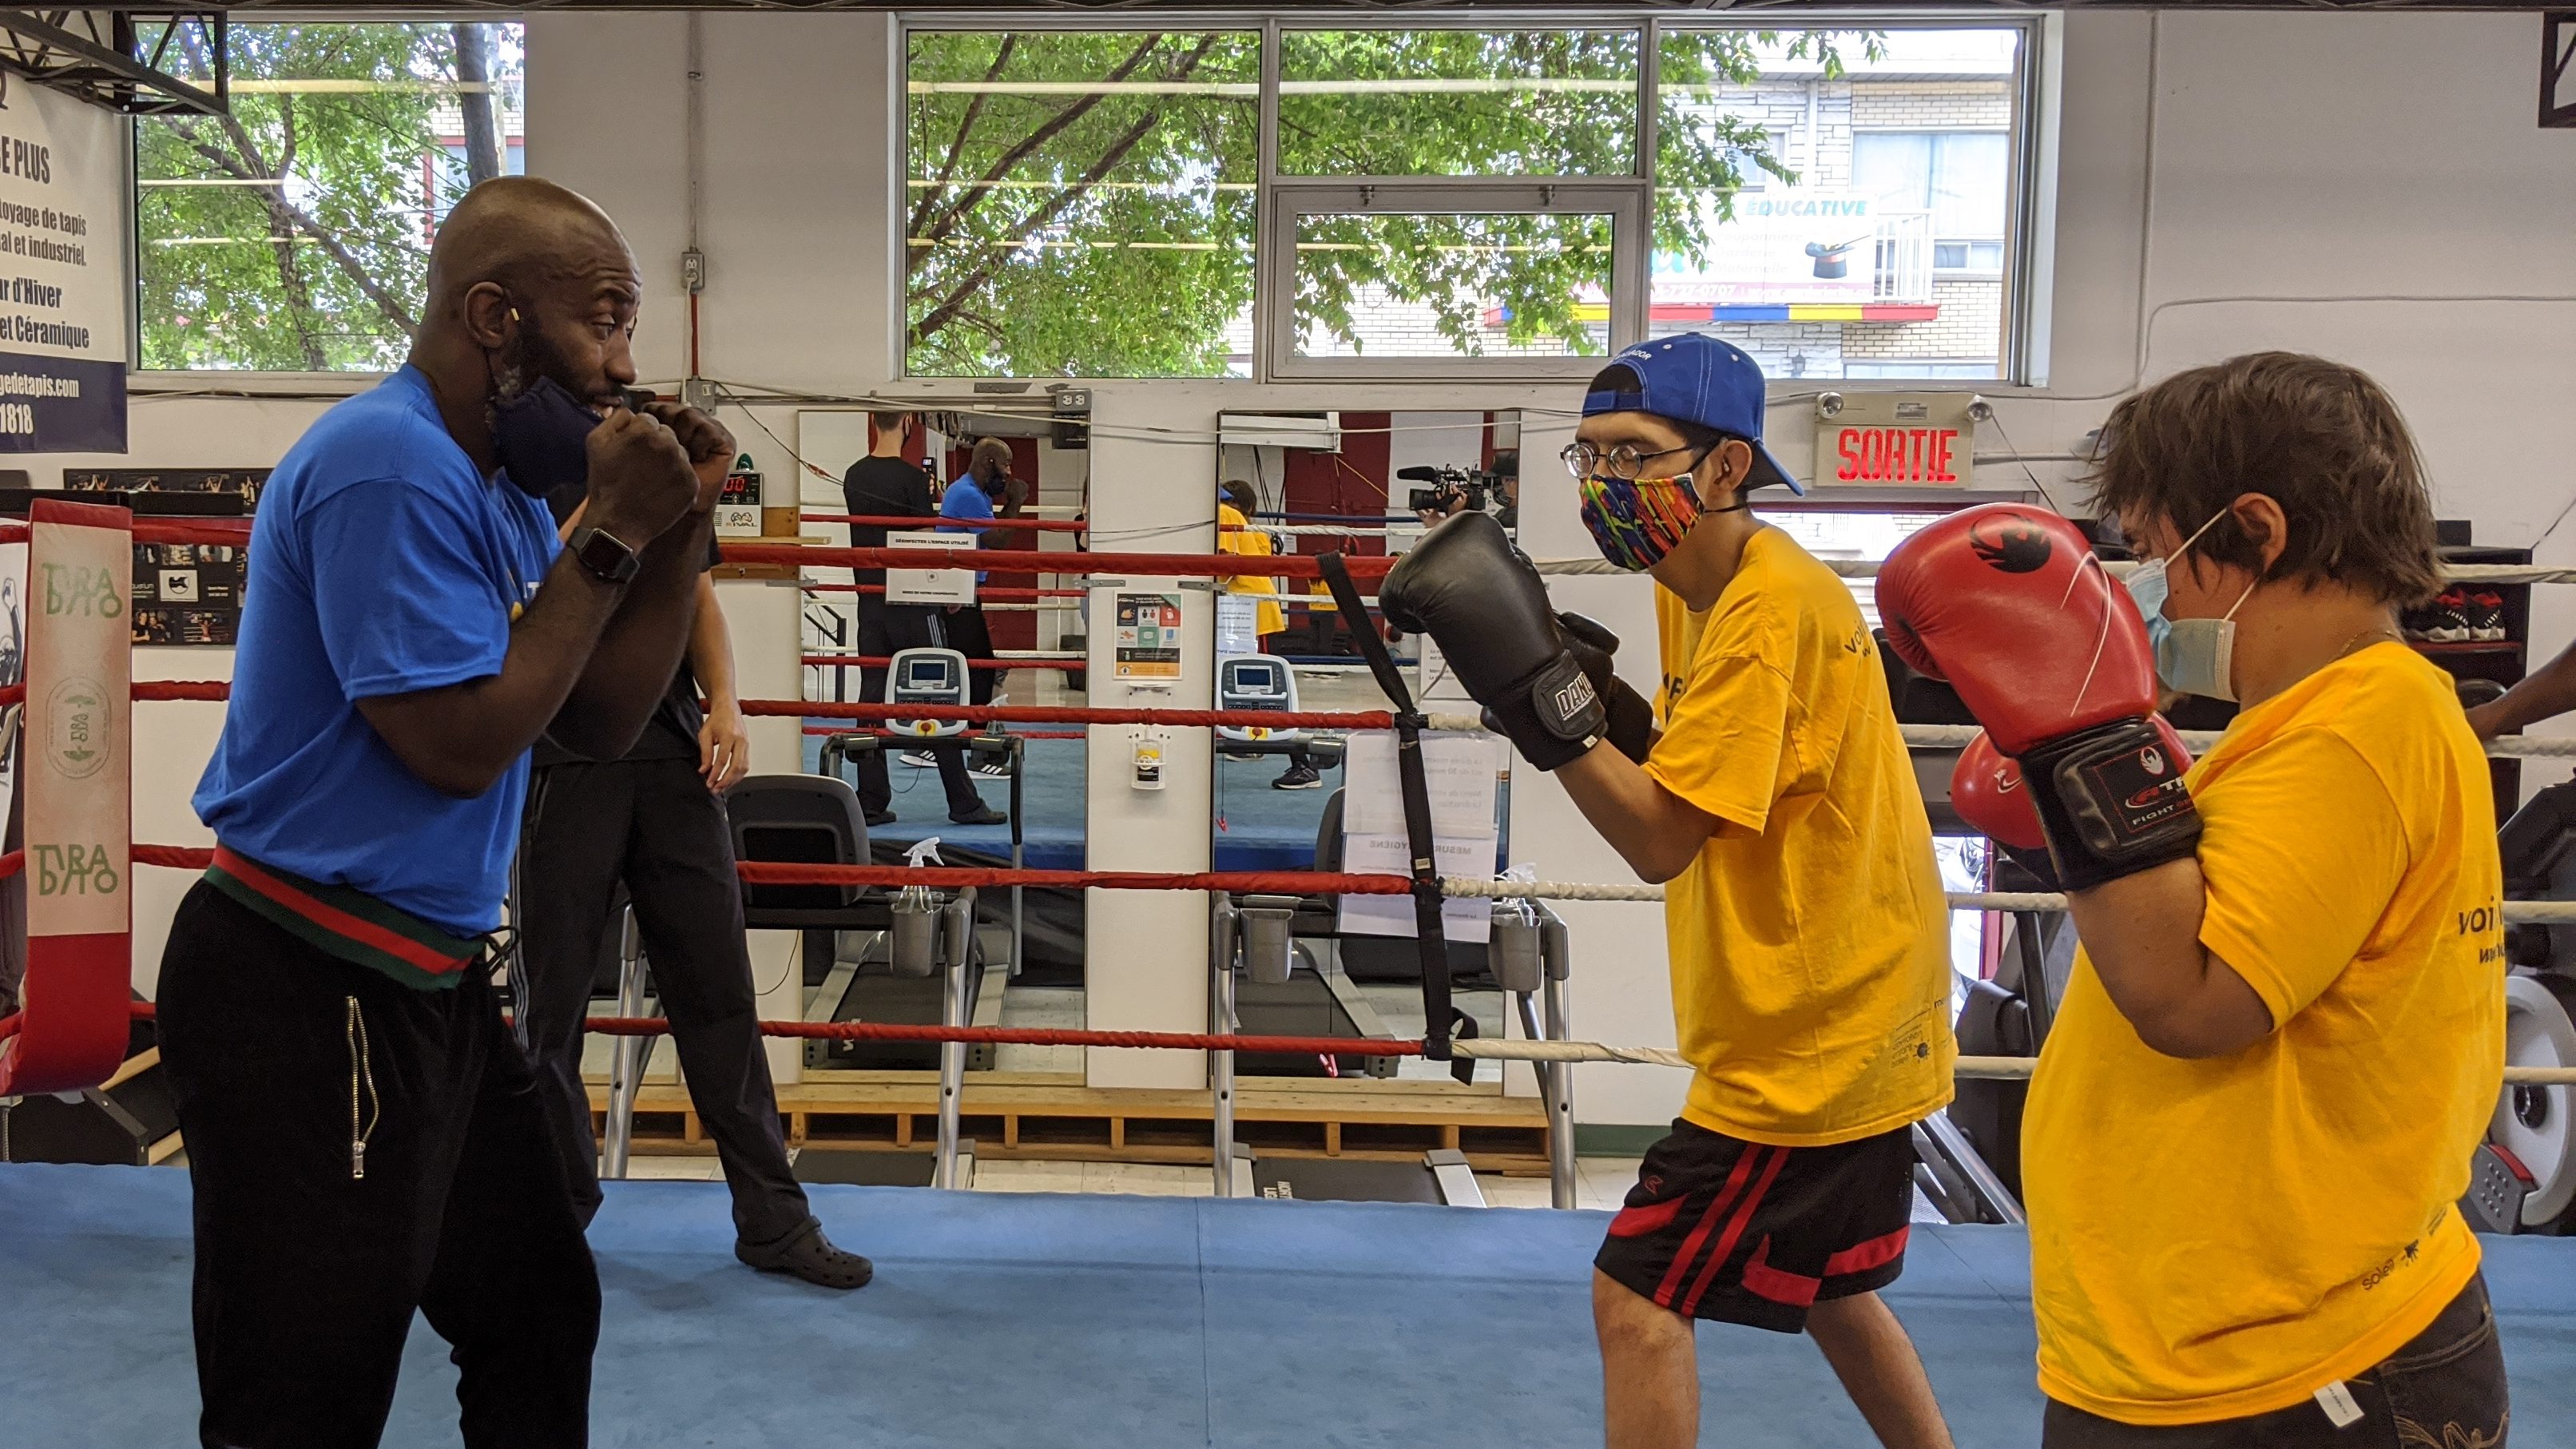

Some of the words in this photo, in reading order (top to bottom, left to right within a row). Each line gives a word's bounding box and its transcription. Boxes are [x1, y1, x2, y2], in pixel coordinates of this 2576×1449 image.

[0, 135, 10, 174] E
[14, 138, 50, 185] PLUS
[42, 207, 57, 230] de
[59, 212, 86, 236] tapis
[1744, 197, 1868, 216] ÉDUCATIVE
[14, 235, 26, 256] et
[29, 235, 87, 267] industriel.
[13, 276, 62, 308] d'Hiver
[0, 316, 14, 340] et
[15, 315, 89, 349] Céramique
[0, 403, 34, 435] 1818
[1836, 428, 1959, 482] SORTIE
[2132, 804, 2173, 825] FIGHT
